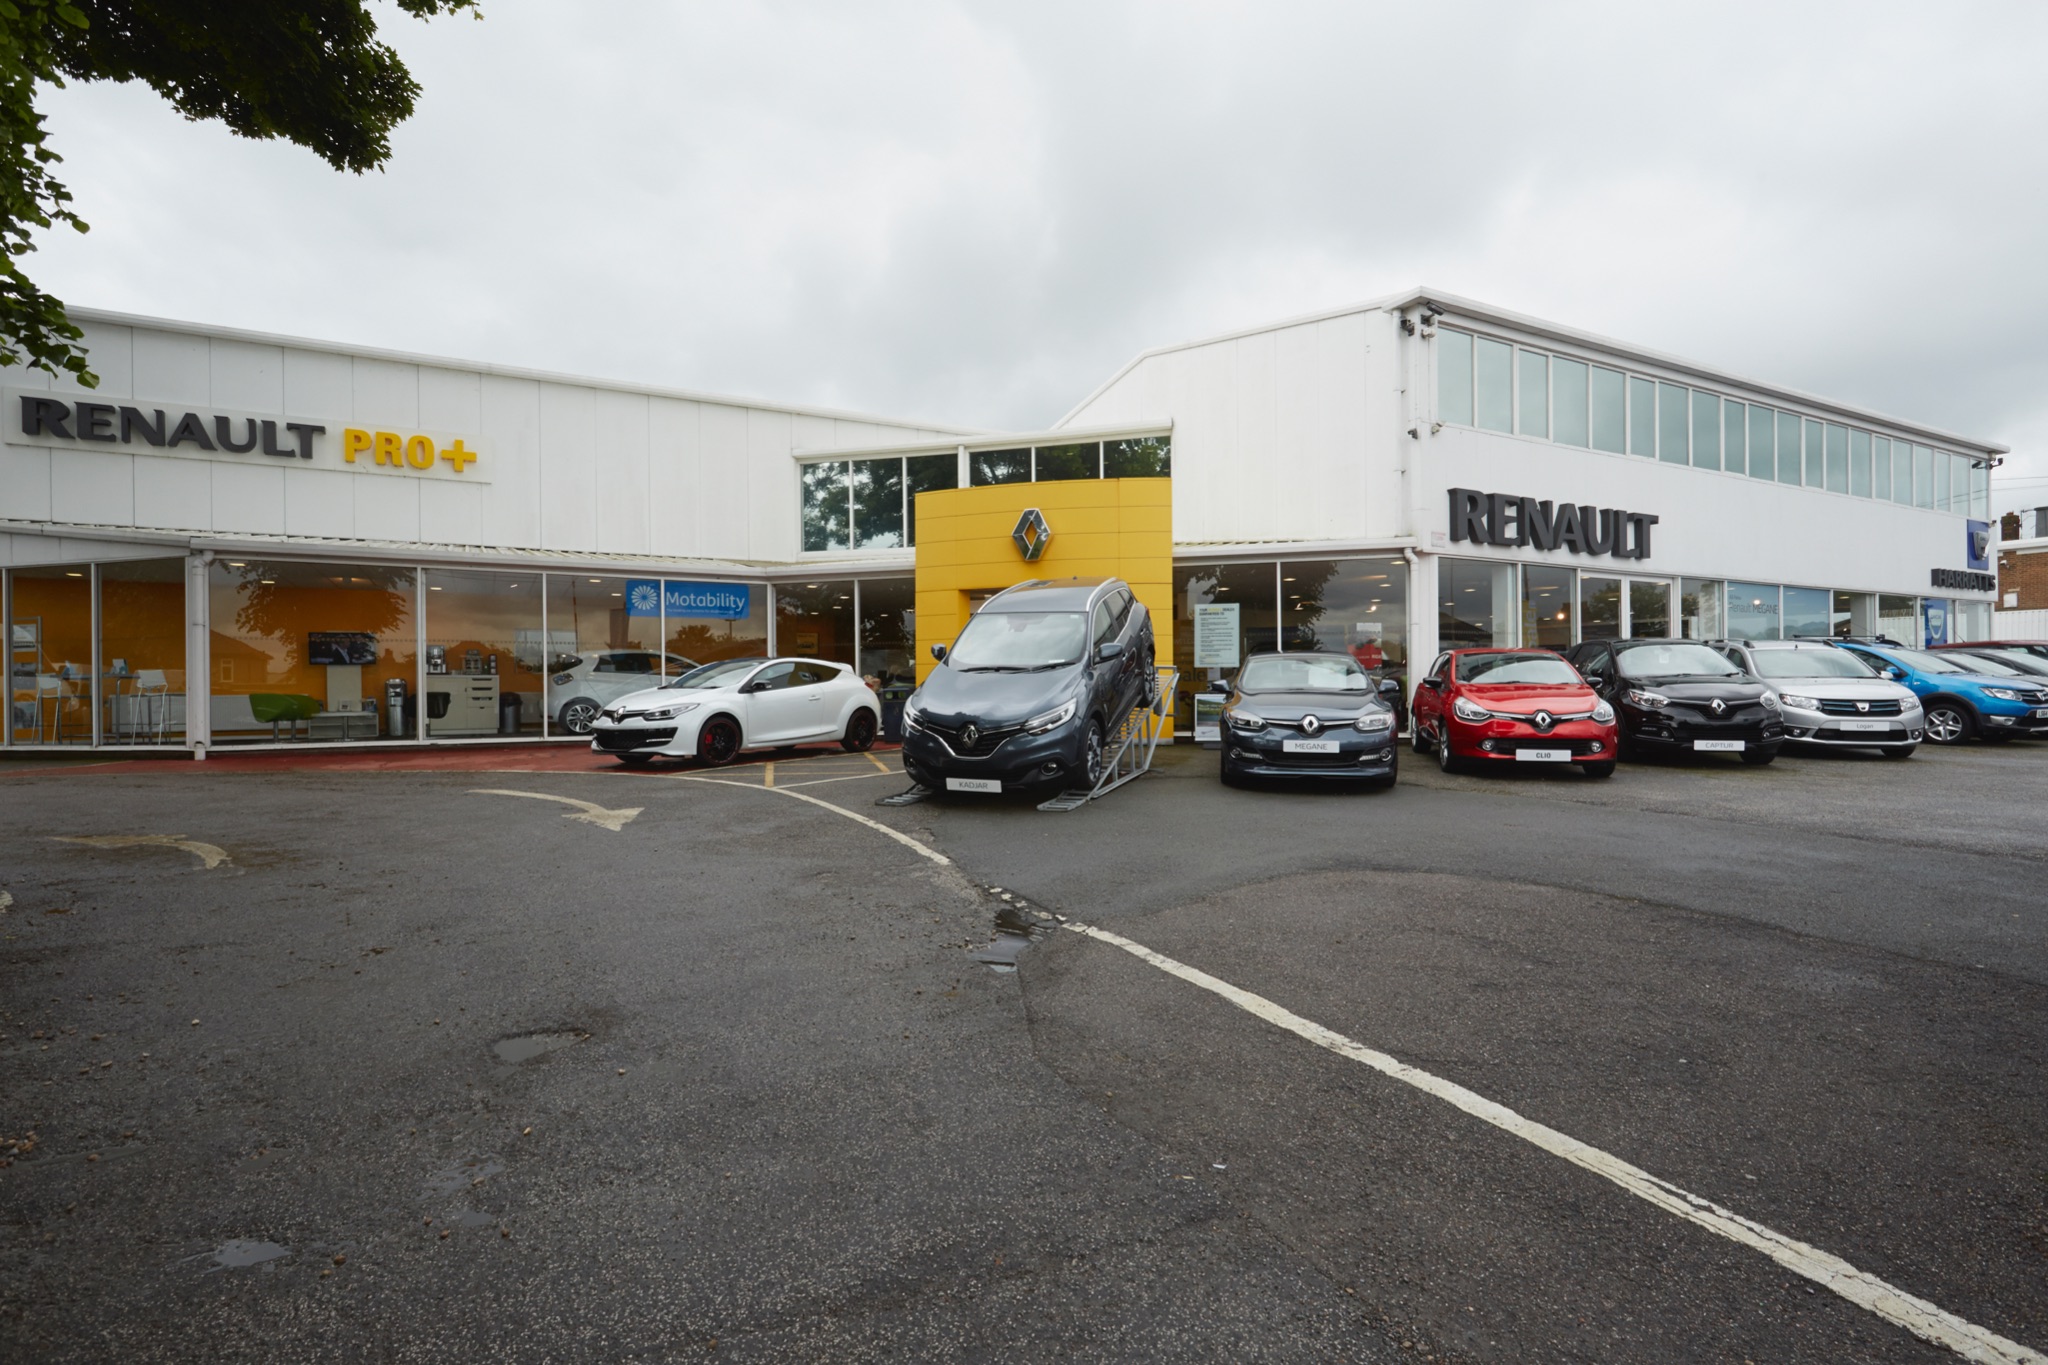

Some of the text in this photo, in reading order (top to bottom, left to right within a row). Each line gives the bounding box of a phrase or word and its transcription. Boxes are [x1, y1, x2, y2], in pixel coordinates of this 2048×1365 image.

[20, 395, 477, 472] RENAULT PRO+
[1447, 487, 1659, 560] RENAULT
[1931, 568, 1996, 592] HARRATTS
[665, 591, 745, 612] Motability
[958, 781, 988, 790] KADJAR
